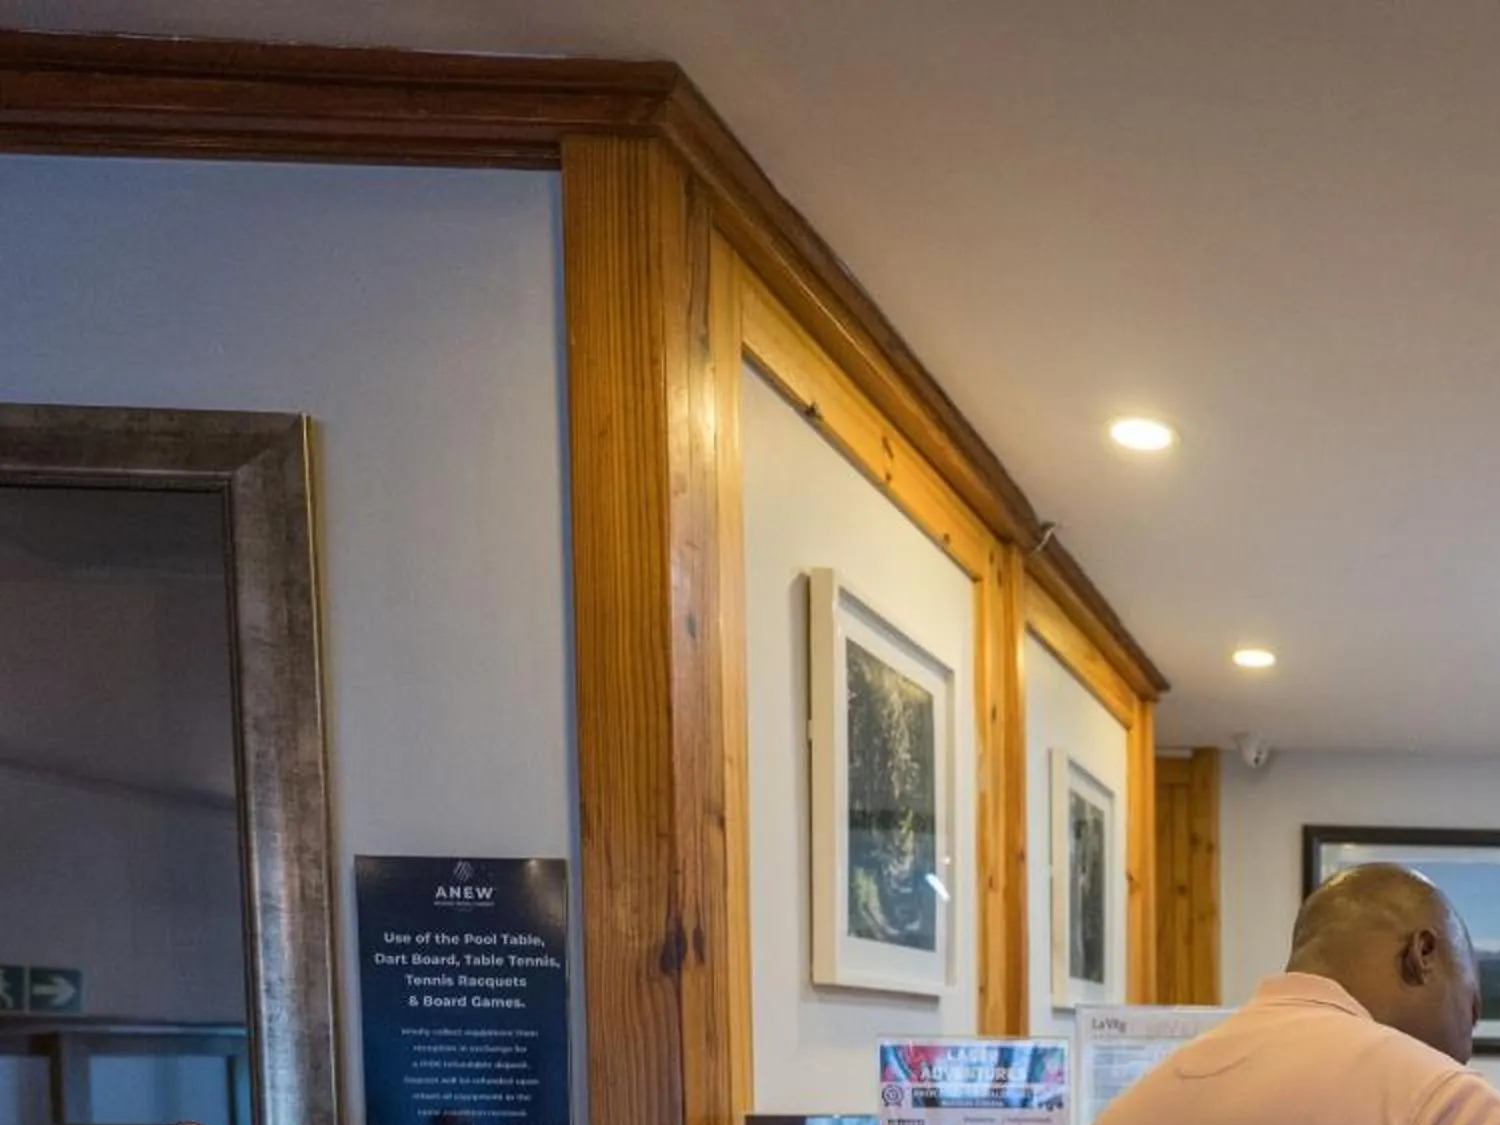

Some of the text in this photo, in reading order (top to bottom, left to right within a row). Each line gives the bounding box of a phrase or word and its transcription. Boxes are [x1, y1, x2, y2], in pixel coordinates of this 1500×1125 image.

[435, 886, 493, 900] ANEW
[384, 931, 546, 948] Use of the Pool Table,
[374, 953, 561, 969] Dart Board, Table Tennis,
[406, 974, 527, 990] Tennis Racquets
[408, 995, 526, 1009] & Board Games.
